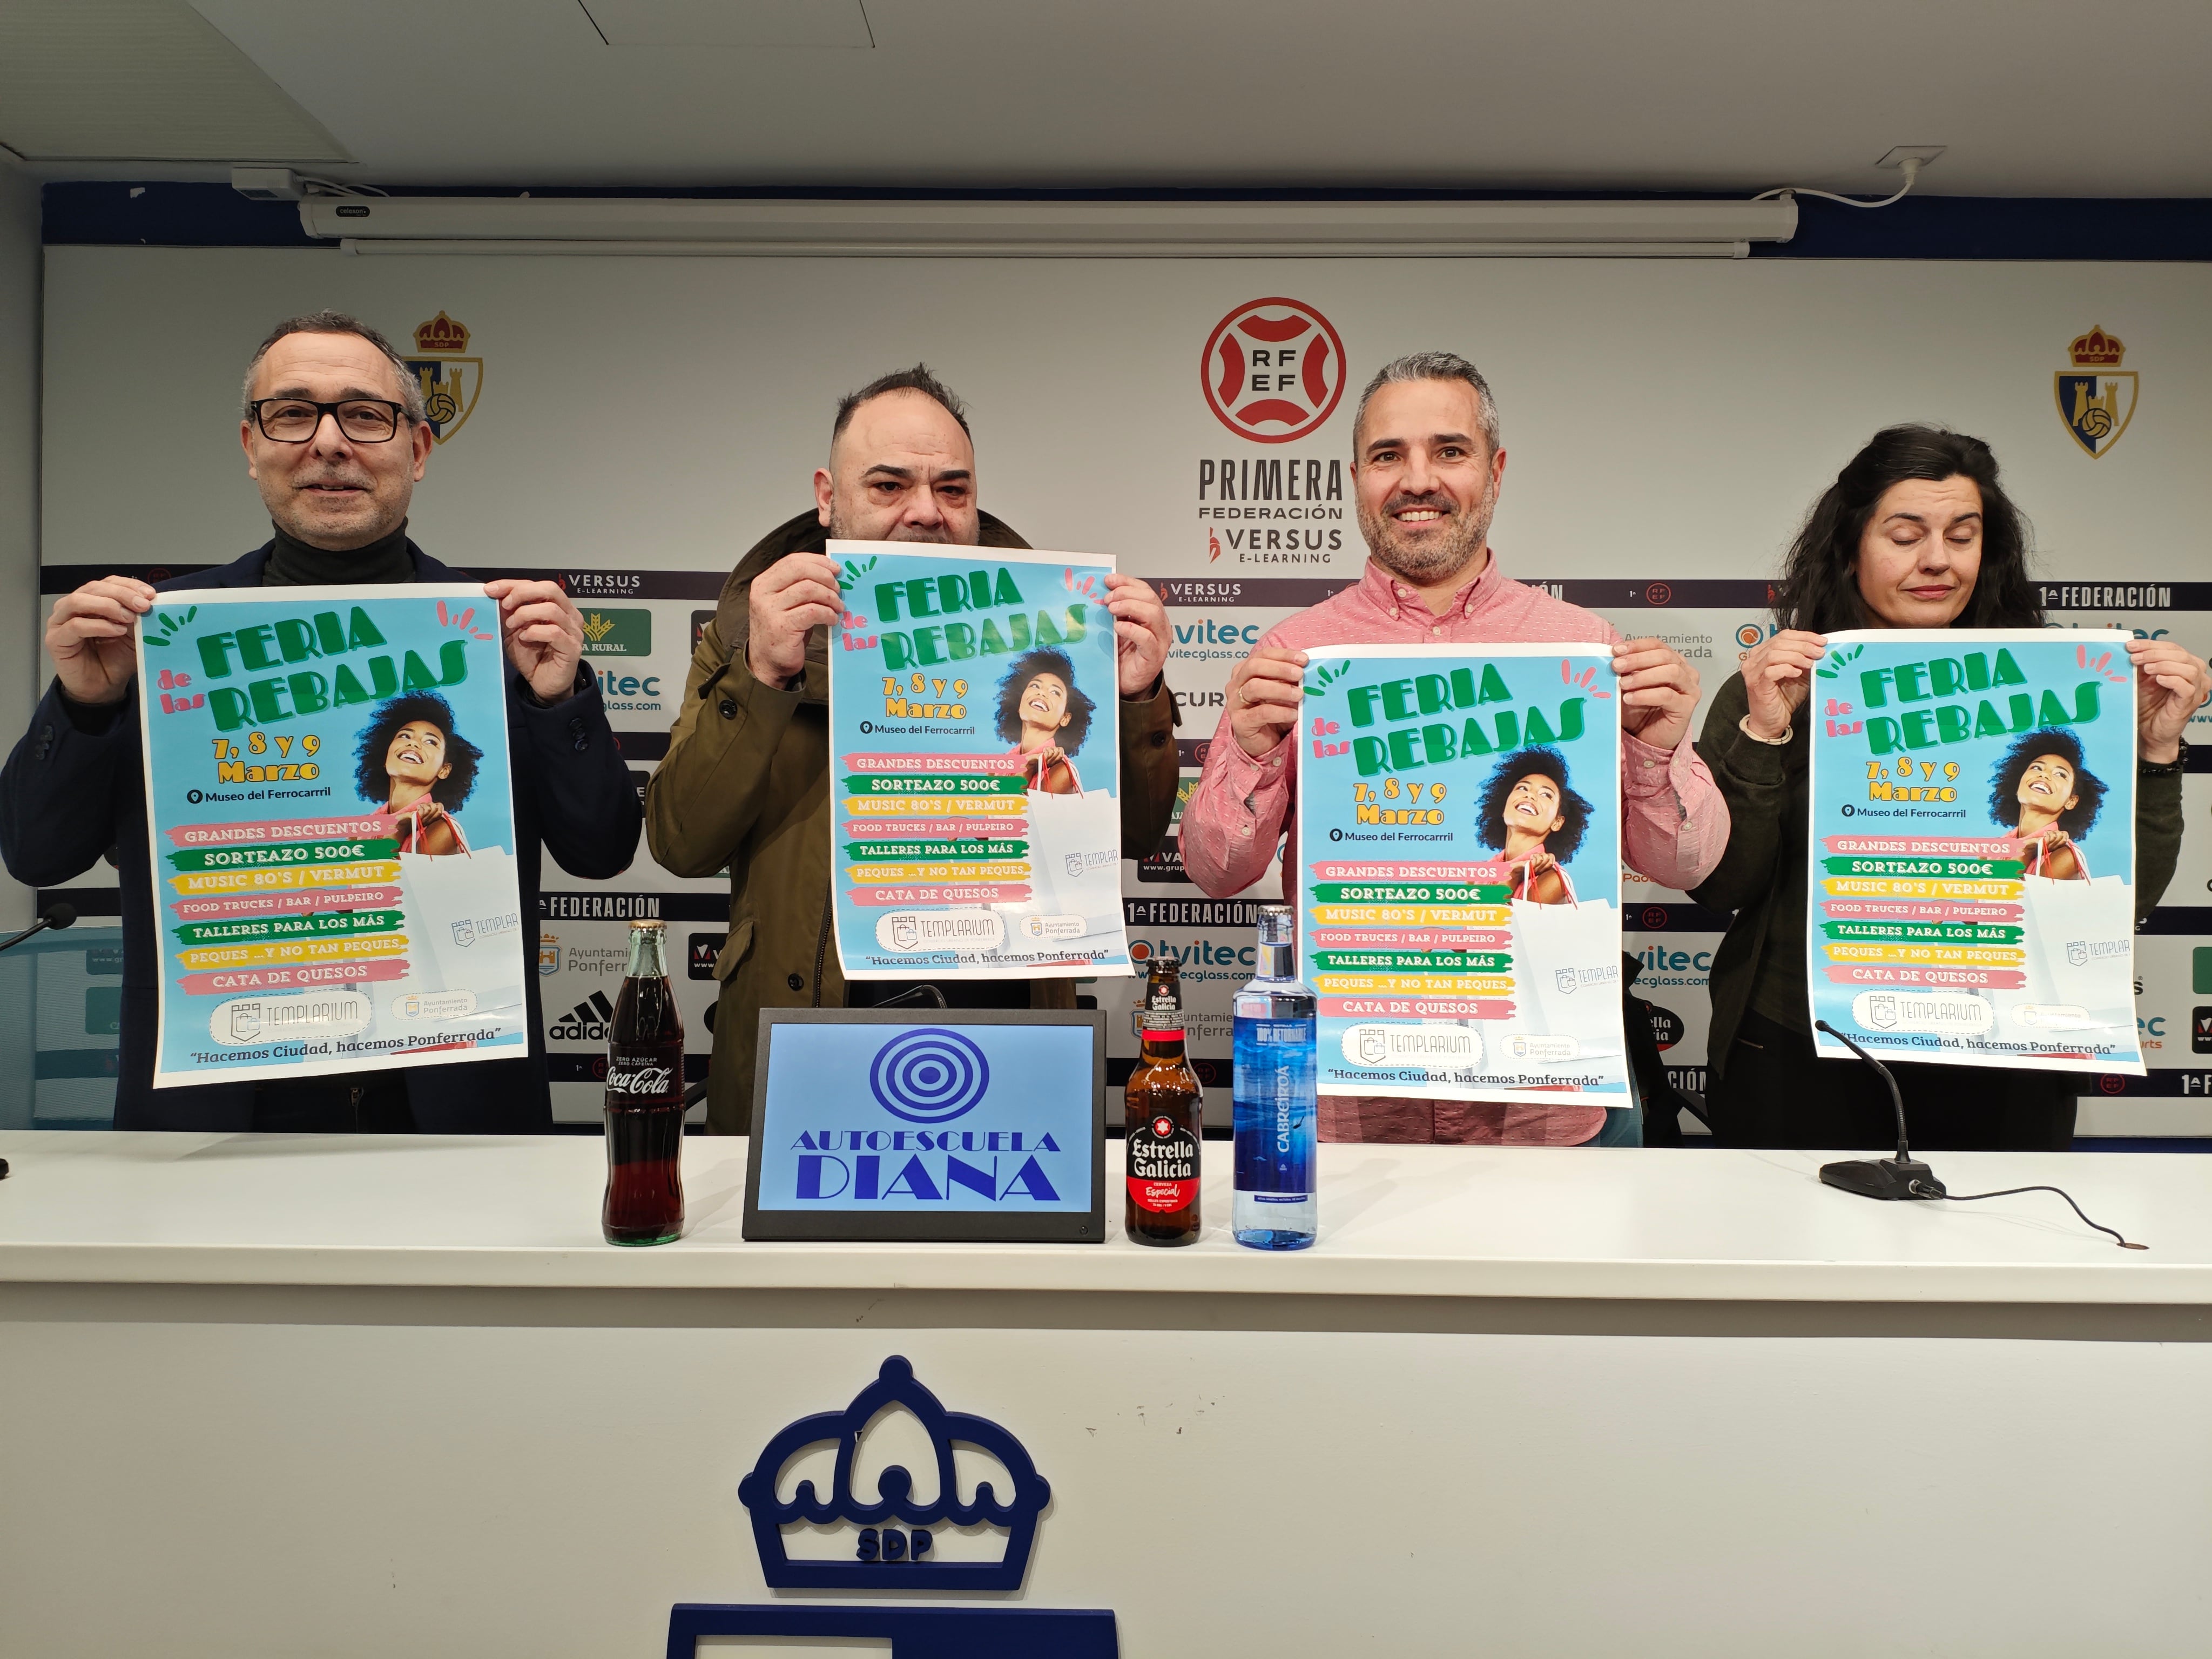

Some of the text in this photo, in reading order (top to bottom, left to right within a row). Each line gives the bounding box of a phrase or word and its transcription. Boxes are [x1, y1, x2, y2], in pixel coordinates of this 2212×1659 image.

[1199, 460, 1342, 501] PRIMERA
[1199, 504, 1342, 520] FEDERACIÓN
[1225, 529, 1342, 550] VERSUS
[1239, 554, 1331, 563] E-LEARNING
[569, 575, 640, 587] VERSUS
[1170, 583, 1242, 595] VERSUS
[875, 567, 1023, 622] FERIA
[2062, 584, 2170, 607] FEDERACIÓN
[840, 611, 868, 629] de
[881, 604, 1088, 670] REBAJAS
[1172, 619, 1260, 644] vitec
[197, 606, 386, 679] FERIA
[842, 633, 879, 651] las
[158, 670, 192, 689] de
[208, 639, 468, 731] REBAJAS
[598, 671, 660, 696] itec
[882, 673, 968, 698] 7, 8 y 9
[1860, 648, 2026, 708] FERIA
[160, 693, 206, 714] las
[1347, 663, 1512, 727] FERIA
[886, 698, 967, 719] Marzo
[1825, 699, 1853, 716] de
[1312, 718, 1340, 736] de
[1866, 682, 2101, 754] REBAJAS
[875, 725, 975, 735] Museo del Ferrocarrril
[1353, 698, 1586, 776] REBAJAS
[1826, 720, 1864, 737] las
[212, 732, 321, 760] 7, 8 y 9
[1313, 740, 1351, 758] las
[218, 758, 320, 784] Marzo
[1866, 757, 1960, 781] 7, 8 y 9
[205, 786, 331, 802] Museo del Ferrocarrril
[1354, 778, 1446, 803] 7, 8 y 9
[1869, 782, 1958, 802] Marzo
[1357, 805, 1444, 825] Marzo
[1857, 808, 1966, 818] Museo del Ferrocarrril
[184, 820, 381, 844] GRANDES DESCUENTOS
[1345, 832, 1453, 841] Museo del Ferrocarrril
[204, 844, 366, 867] SORTEAZO 500€
[1326, 867, 1496, 878] GRANDES DESCUENTOS
[875, 887, 999, 902] CATA DE QUESOS
[1340, 888, 1481, 901] SORTEAZO 500€
[550, 894, 659, 918] FEDERACIÓN
[1150, 900, 1257, 924] FEDERACIÓN
[1325, 909, 1375, 921] MUSIC
[1382, 909, 1415, 921] 80'S
[1430, 911, 1496, 922] VERMUT
[921, 918, 995, 939] TEMPLARIUM
[1320, 933, 1351, 942] FOOD
[1355, 934, 1398, 942] TRUCKS
[1408, 934, 1430, 943] BAR
[1442, 934, 1495, 943] PULPEIRO
[569, 947, 628, 959] Ayuntami
[1328, 955, 1392, 966] TALLERES
[1397, 955, 1432, 966] PARA
[1436, 956, 1462, 967] LOS
[569, 960, 627, 976] Ponferr
[1324, 979, 1374, 988] PEQUES
[1401, 979, 1421, 989] NO
[1426, 980, 1453, 989] TAN
[1456, 980, 1507, 990] PEQUES
[1343, 1002, 1478, 1014] CATA DE QUESOS
[549, 1022, 609, 1040] adid
[1188, 1024, 1233, 1041] nferra
[1390, 1035, 1471, 1053] TEMPLARIUM
[1530, 1049, 1571, 1057] Ponferrada
[1911, 1036, 1963, 1049] Ciudad,
[1966, 1038, 2027, 1051] hacemos
[606, 1066, 673, 1094] Coca-Cola
[1399, 1071, 1451, 1084] Ciudad,
[1454, 1072, 1515, 1084] hacemos
[791, 1130, 1061, 1152] AUTOESCUELA
[1132, 1139, 1193, 1159] Estrella
[1134, 1156, 1191, 1178] Galicia
[796, 1154, 1061, 1202] DIANA
[1146, 1184, 1180, 1198] Especial
[856, 1528, 933, 1562] SDP
